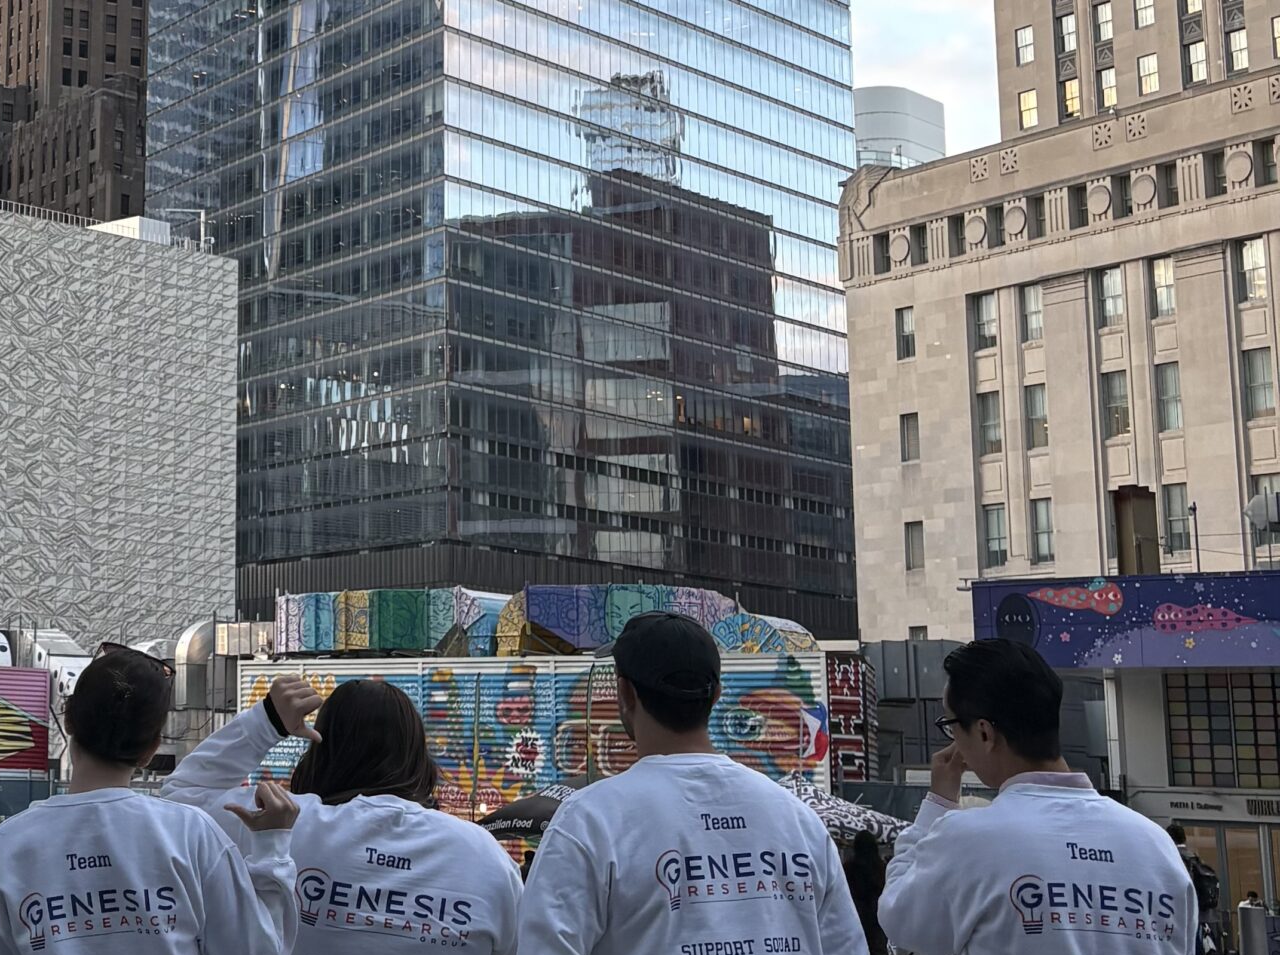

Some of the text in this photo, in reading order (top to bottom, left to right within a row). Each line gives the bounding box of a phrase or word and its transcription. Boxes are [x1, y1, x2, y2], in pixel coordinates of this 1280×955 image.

[511, 818, 534, 829] Food
[701, 813, 747, 831] Team
[66, 853, 112, 871] Team
[365, 847, 412, 871] Team
[1066, 842, 1115, 863] Team
[663, 850, 811, 885] GENESIS
[688, 880, 814, 897] RESEARCH
[26, 886, 177, 926] GENESIS
[301, 875, 472, 926] GENESIS
[1016, 882, 1175, 919] GENESIS
[50, 914, 177, 937] RESEARCH
[137, 925, 175, 935] GROUP
[326, 909, 470, 941] RESEARCH
[1050, 912, 1174, 935] RESEARCH
[419, 937, 468, 947] GROUP
[764, 937, 801, 953] SQUAD
